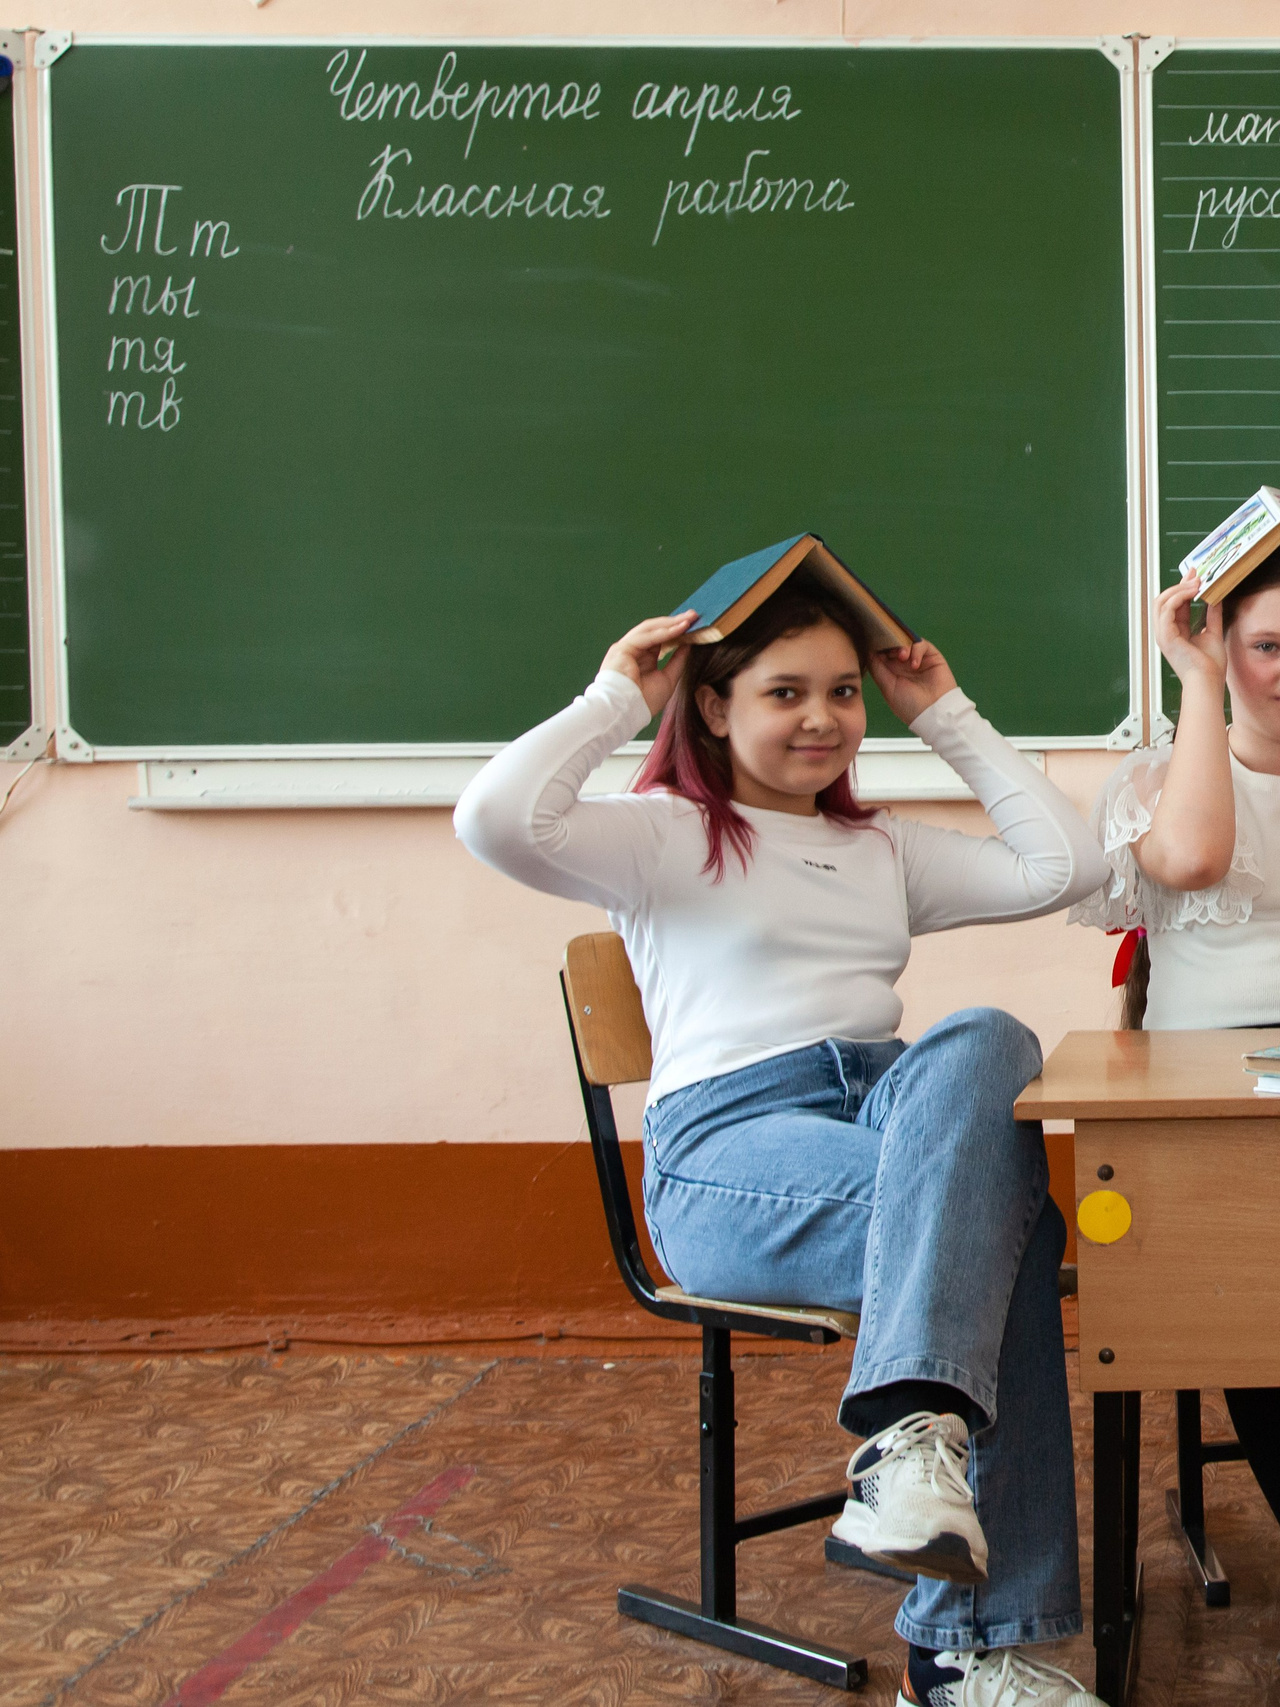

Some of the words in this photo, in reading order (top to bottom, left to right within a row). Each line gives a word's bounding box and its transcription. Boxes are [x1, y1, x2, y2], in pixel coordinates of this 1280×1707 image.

[326, 49, 600, 158] Четвертое
[631, 82, 802, 155] апреля
[355, 144, 610, 222] Классная
[653, 150, 854, 246] работа
[108, 274, 201, 319] ты
[106, 335, 186, 374] тя
[106, 376, 184, 432] тв
